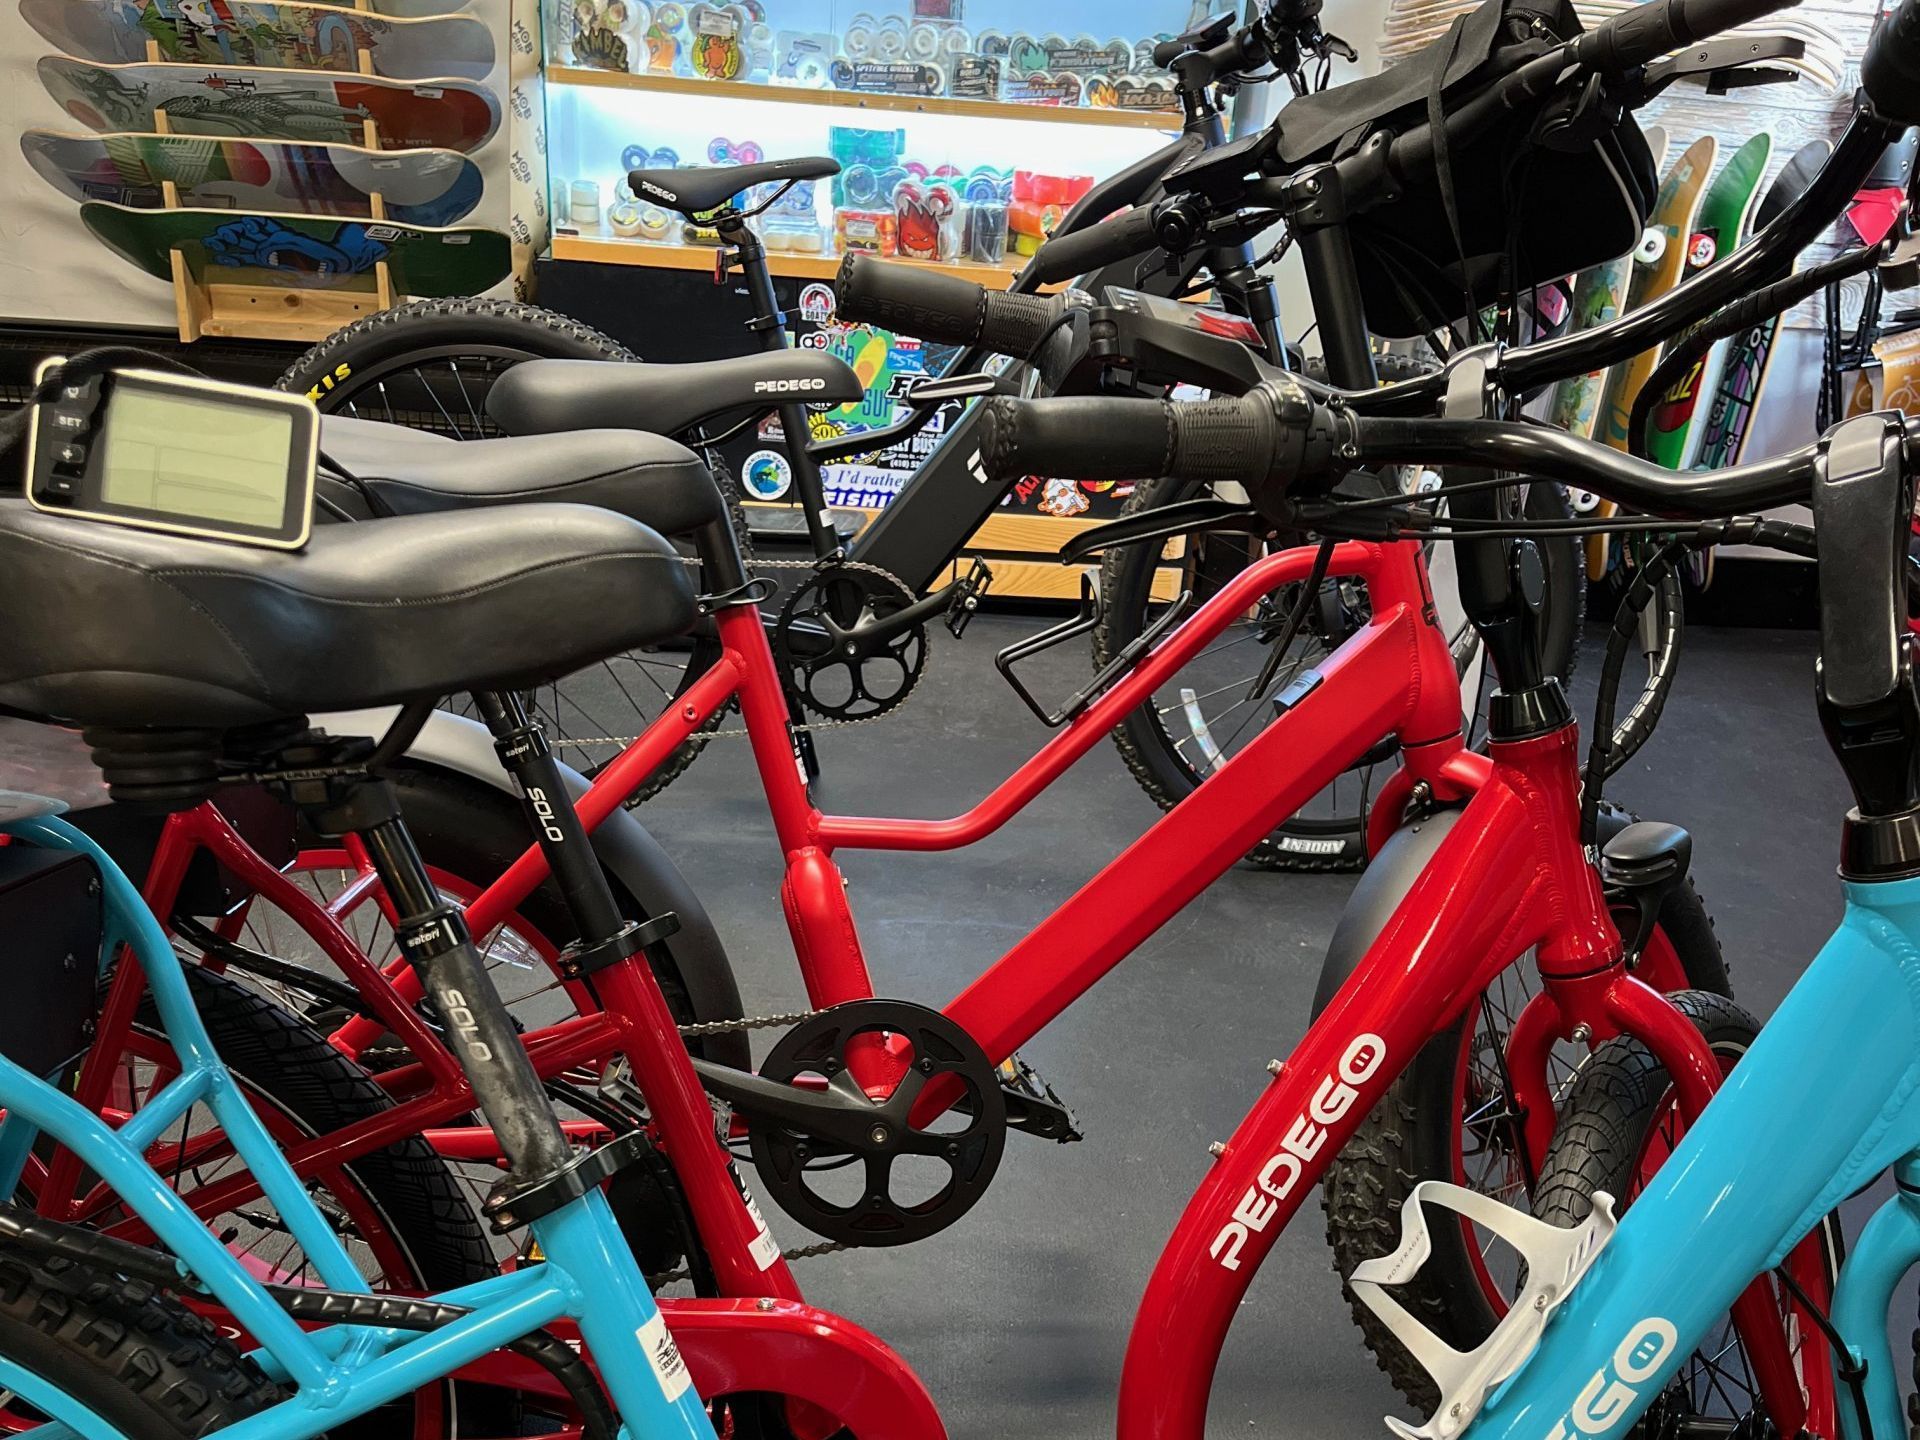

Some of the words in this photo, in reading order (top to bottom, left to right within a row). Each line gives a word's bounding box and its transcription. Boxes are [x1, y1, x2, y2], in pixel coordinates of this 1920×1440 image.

[514, 20, 533, 55] MOB
[856, 64, 889, 73] SPITFIRE
[890, 65, 920, 73] WHEELS
[512, 86, 532, 120] MOB
[512, 151, 532, 183] MOB
[641, 180, 677, 202] PEDEGO
[512, 213, 532, 245] MOB
[754, 378, 826, 393] PEDEGO
[58, 415, 82, 429] SET
[836, 470, 860, 484] I'd
[505, 743, 529, 757] satori
[527, 787, 564, 842] SOLO
[1277, 837, 1346, 854] ARDENT
[407, 928, 440, 948] satori
[441, 988, 493, 1062] SOLO
[1209, 1033, 1387, 1271] PEDEGO
